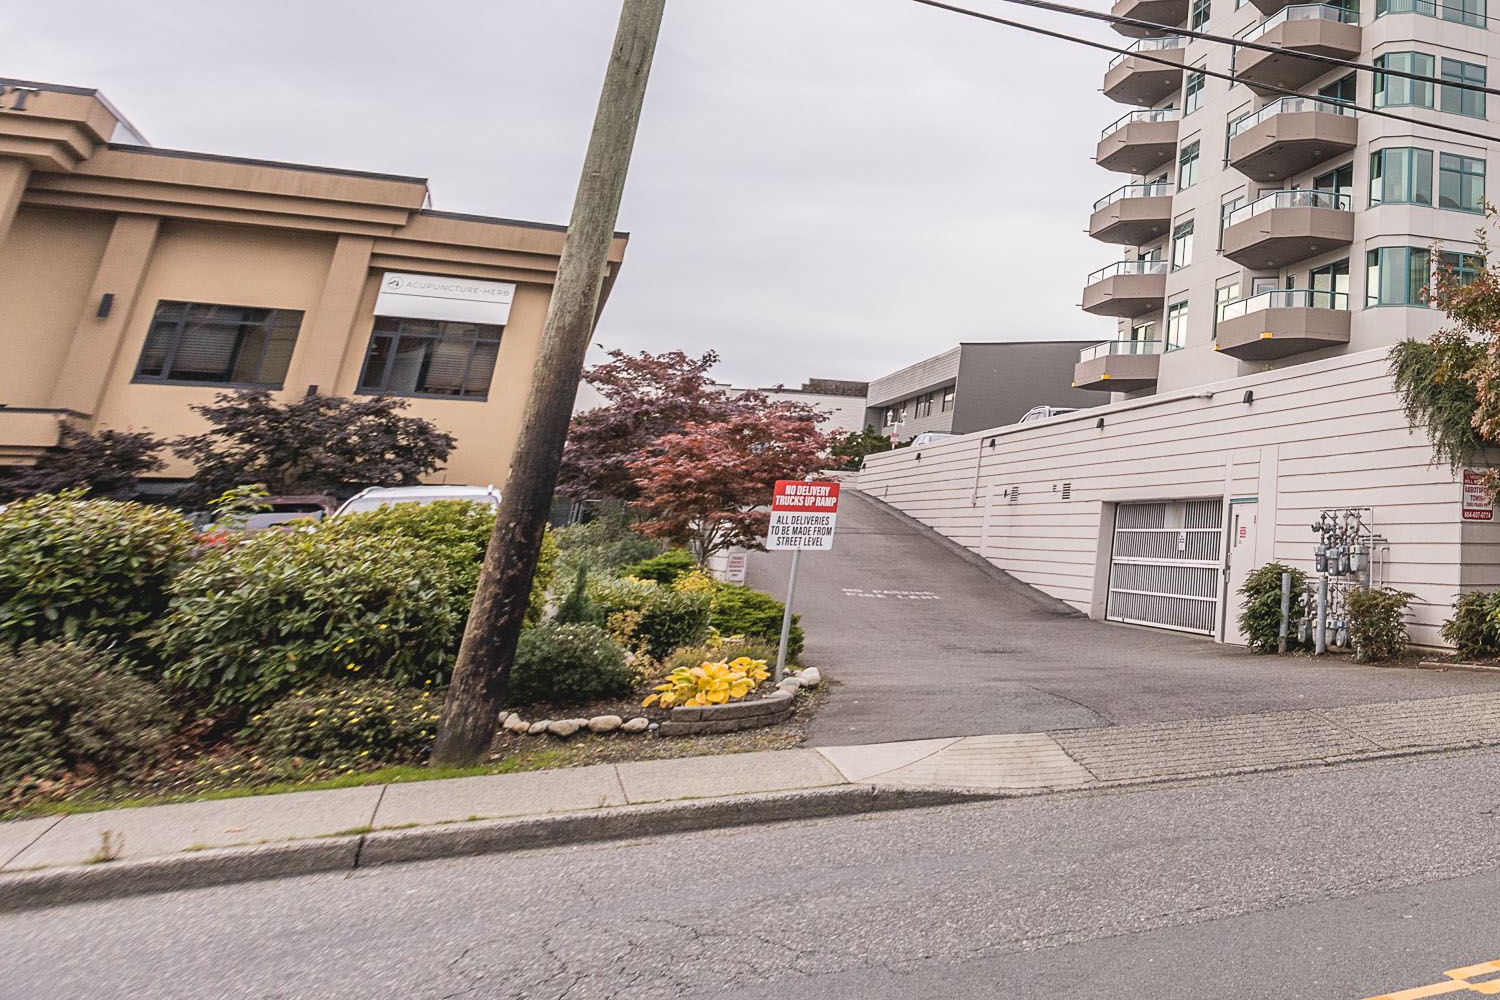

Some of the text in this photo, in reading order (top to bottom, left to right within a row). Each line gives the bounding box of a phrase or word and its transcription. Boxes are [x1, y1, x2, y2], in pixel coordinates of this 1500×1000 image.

[785, 485, 831, 496] NO DELIVERY
[776, 495, 837, 508] TRUCKS UP RAMP
[776, 515, 830, 526] ALL DELIVERIES
[771, 526, 832, 536] TO BE MADE FROM
[776, 536, 823, 547] STREET LEVEL
